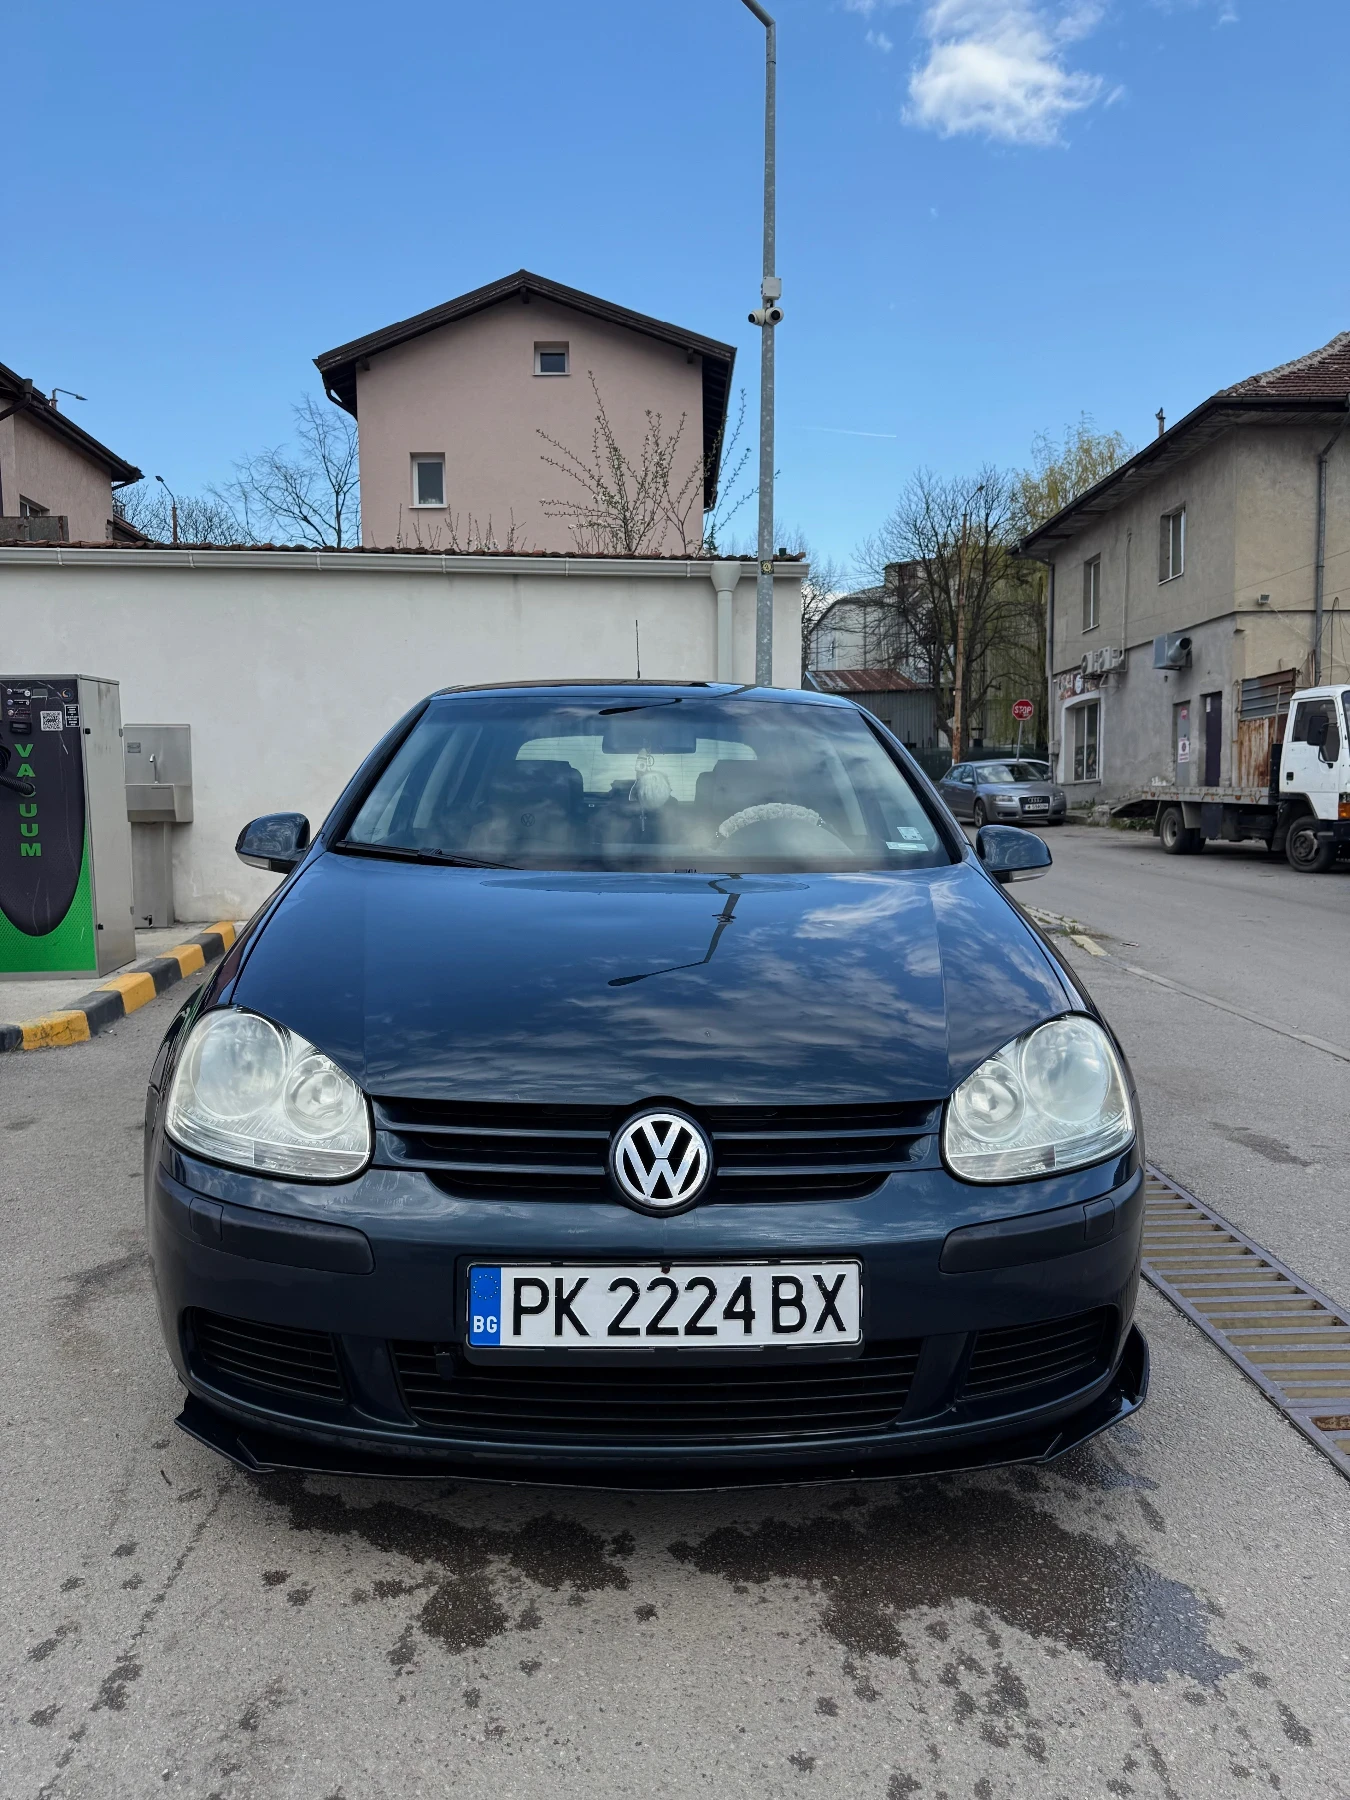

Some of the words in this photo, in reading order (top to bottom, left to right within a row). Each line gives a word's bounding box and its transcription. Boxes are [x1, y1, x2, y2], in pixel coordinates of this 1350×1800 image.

[14, 743, 42, 857] VAUUM
[617, 1113, 708, 1206] VW
[473, 1315, 498, 1333] BG
[513, 1277, 590, 1336] PK
[607, 1276, 756, 1336] 2224
[771, 1273, 847, 1334] BX
